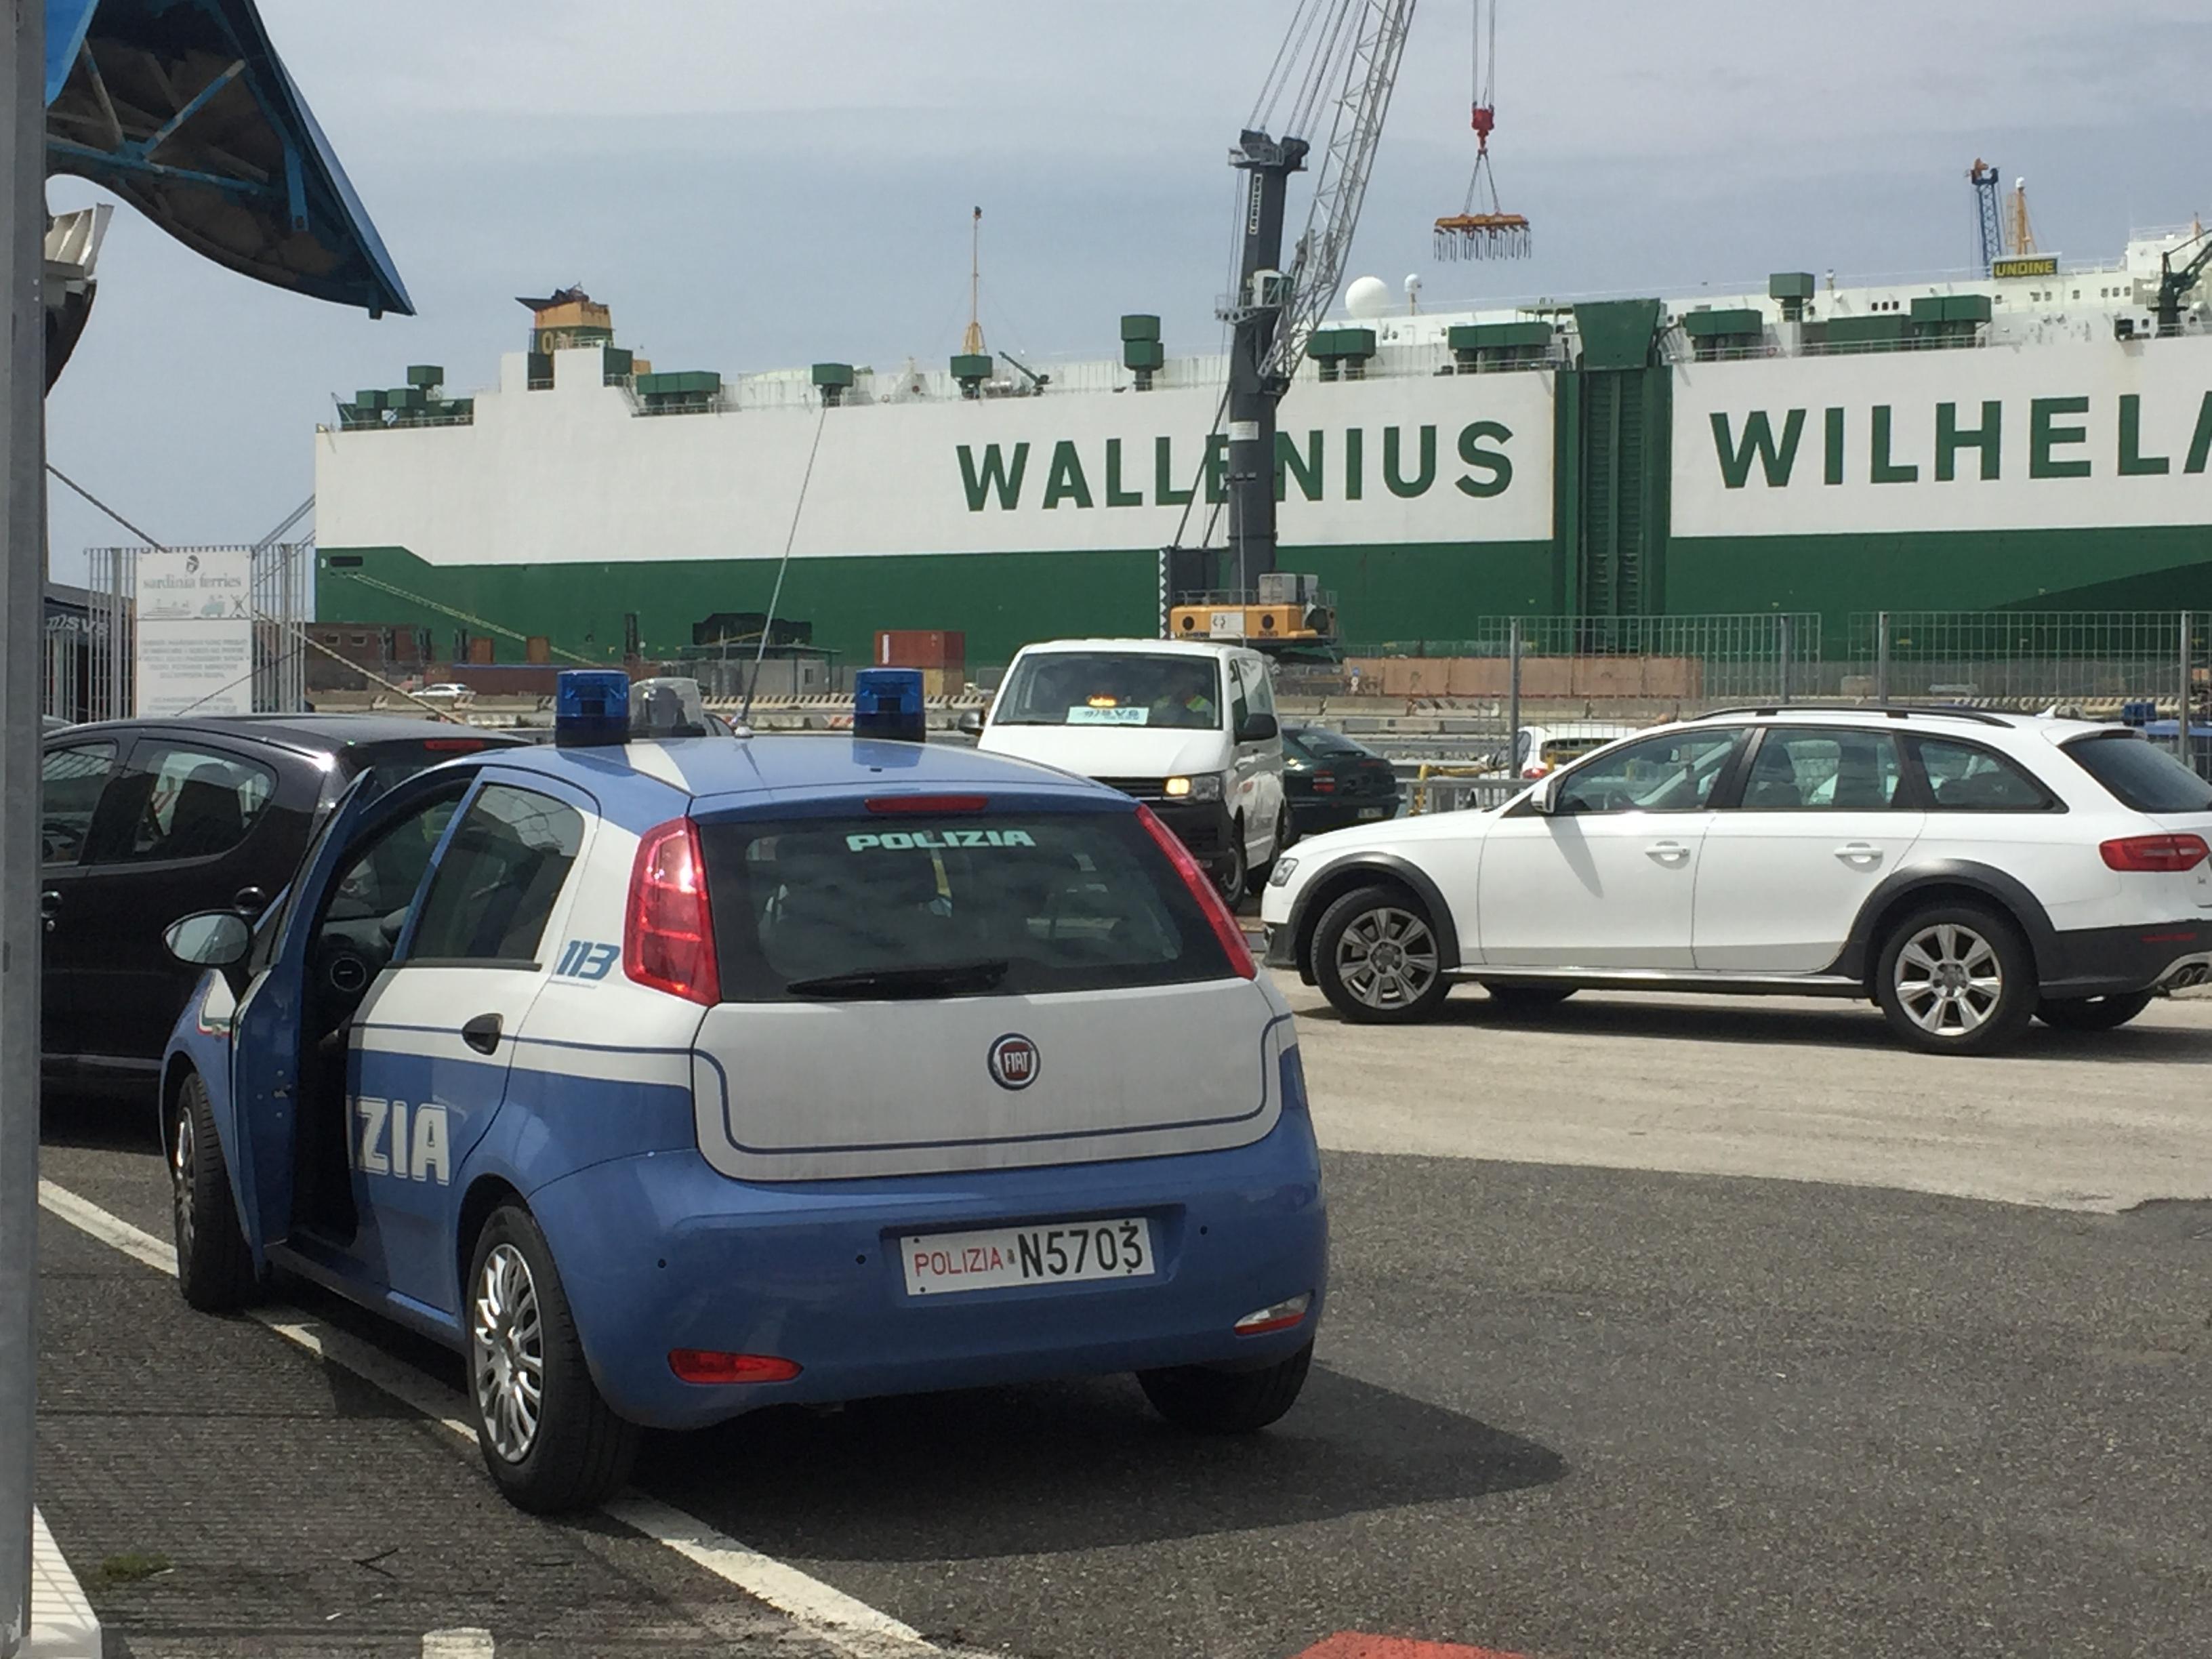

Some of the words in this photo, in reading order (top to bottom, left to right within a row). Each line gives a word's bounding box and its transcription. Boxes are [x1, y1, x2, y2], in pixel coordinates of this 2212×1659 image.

[1995, 260, 2054, 276] UNDINE
[143, 573, 196, 590] sardinia
[199, 571, 242, 588] ferries
[846, 830, 1036, 852] POLIZIA
[556, 940, 621, 981] 113
[1004, 1051, 1029, 1073] FIAT
[914, 1246, 1004, 1277] POLIZIA
[1018, 1224, 1143, 1278] N5703
